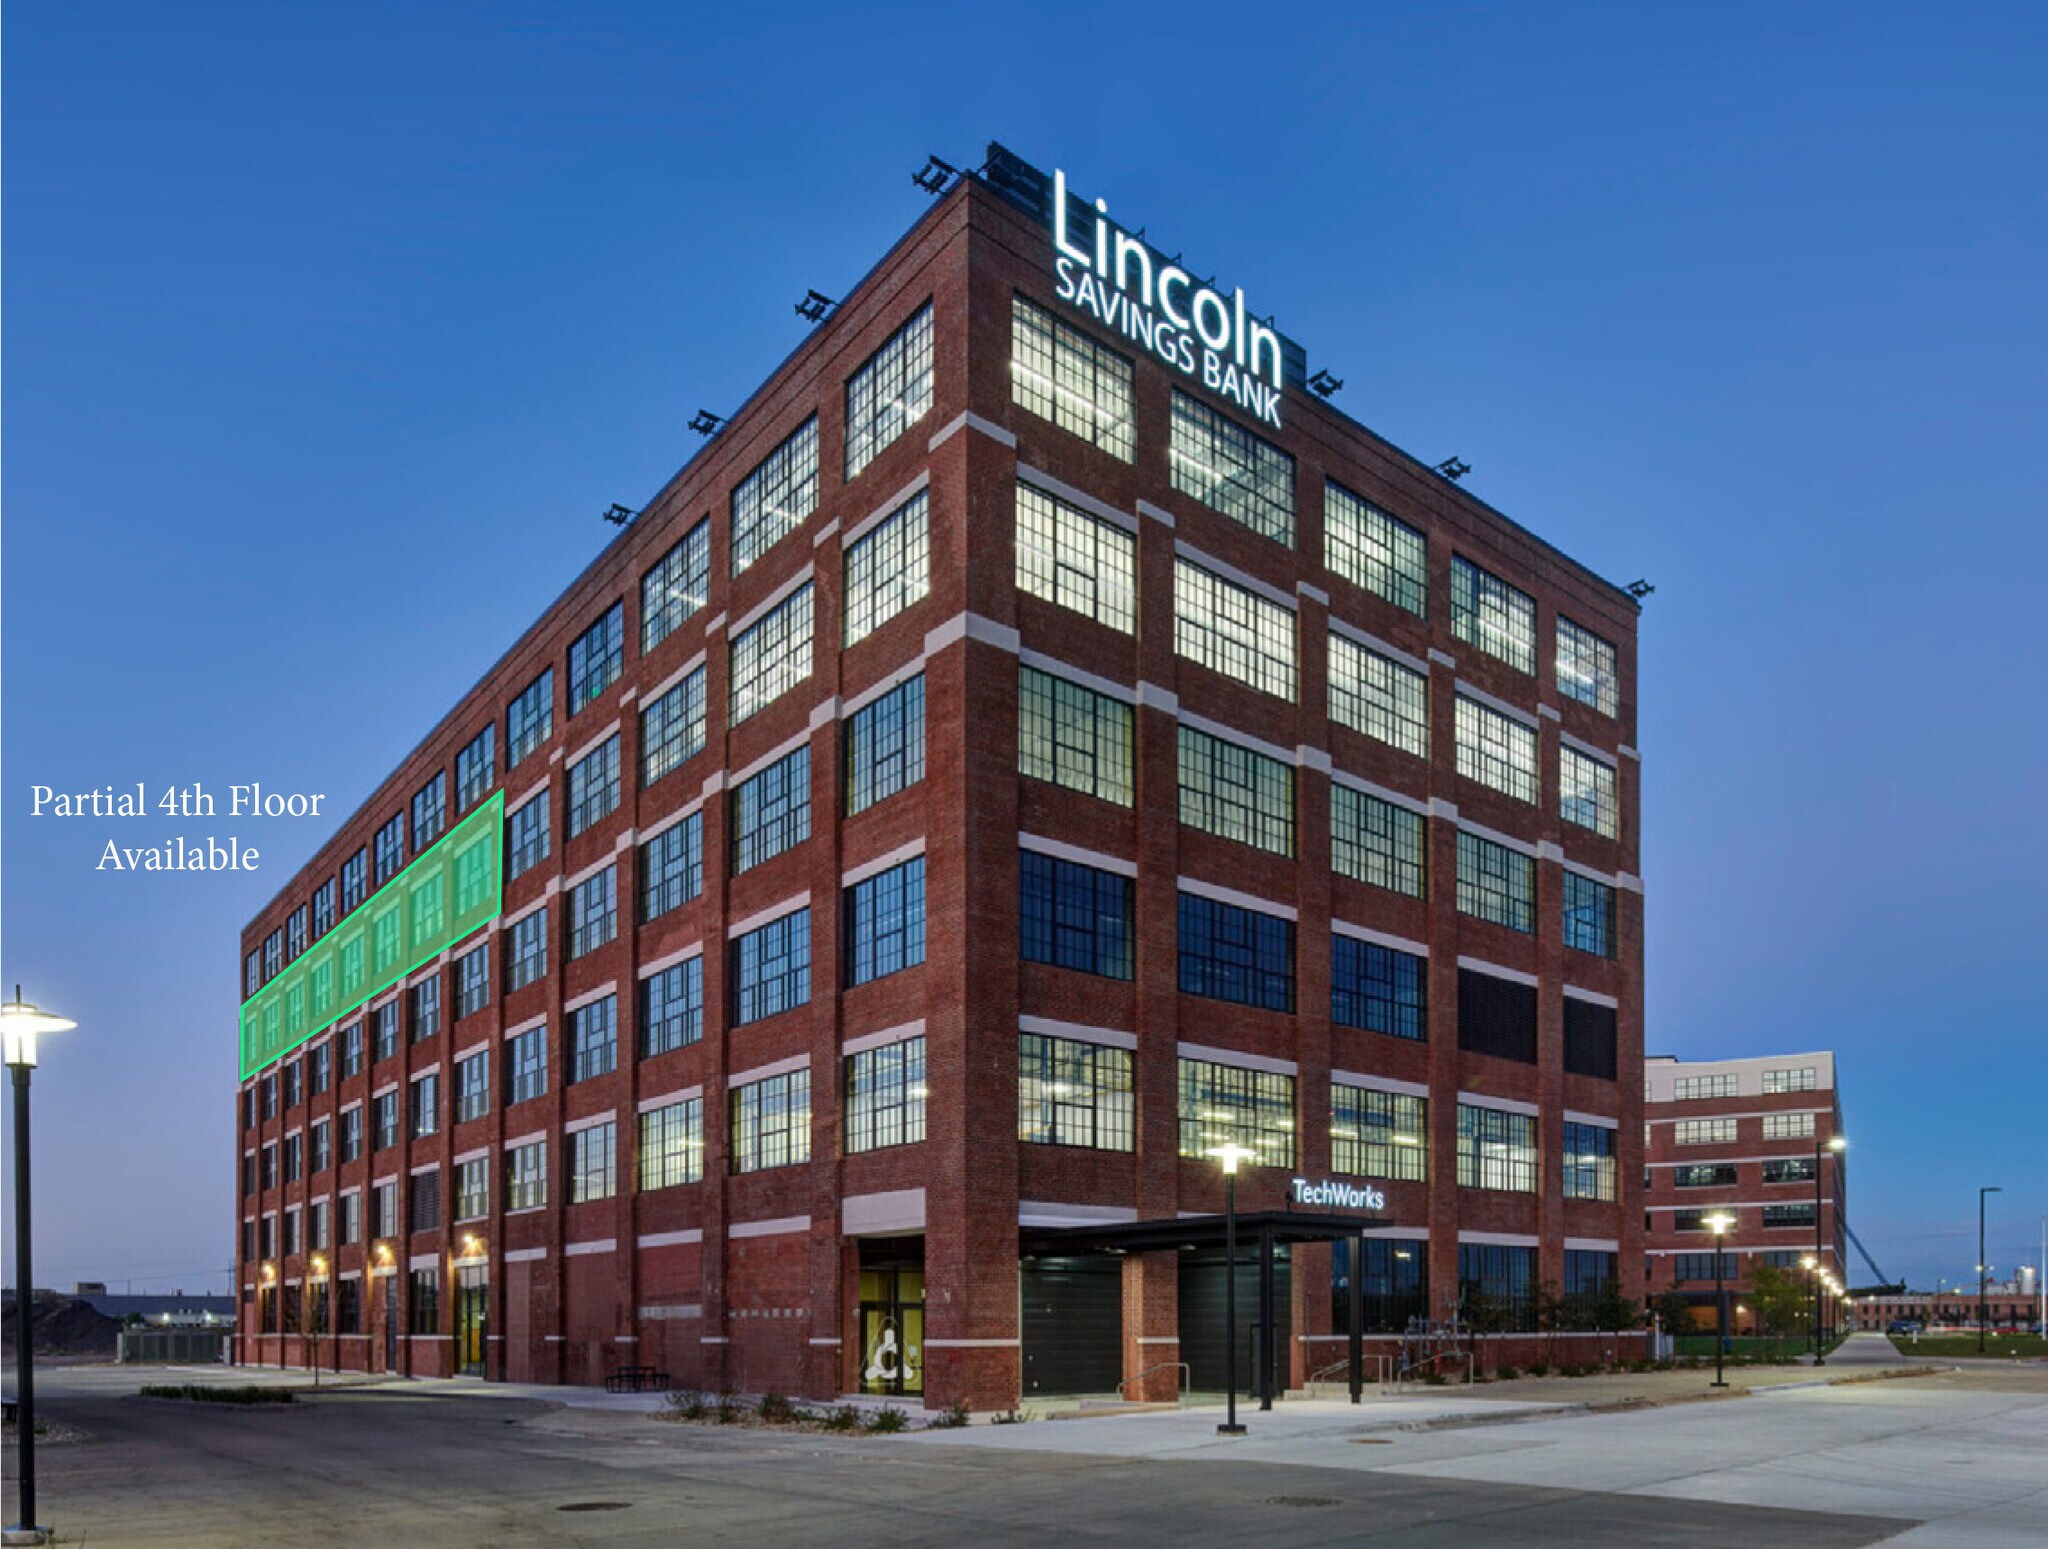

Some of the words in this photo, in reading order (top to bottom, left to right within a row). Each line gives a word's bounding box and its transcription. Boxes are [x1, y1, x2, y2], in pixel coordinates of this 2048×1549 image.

[1054, 167, 1283, 390] Lincoln
[1055, 257, 1195, 374] SAVINGS
[1203, 349, 1282, 430] BANK
[1292, 1178, 1385, 1211] TechWorks
